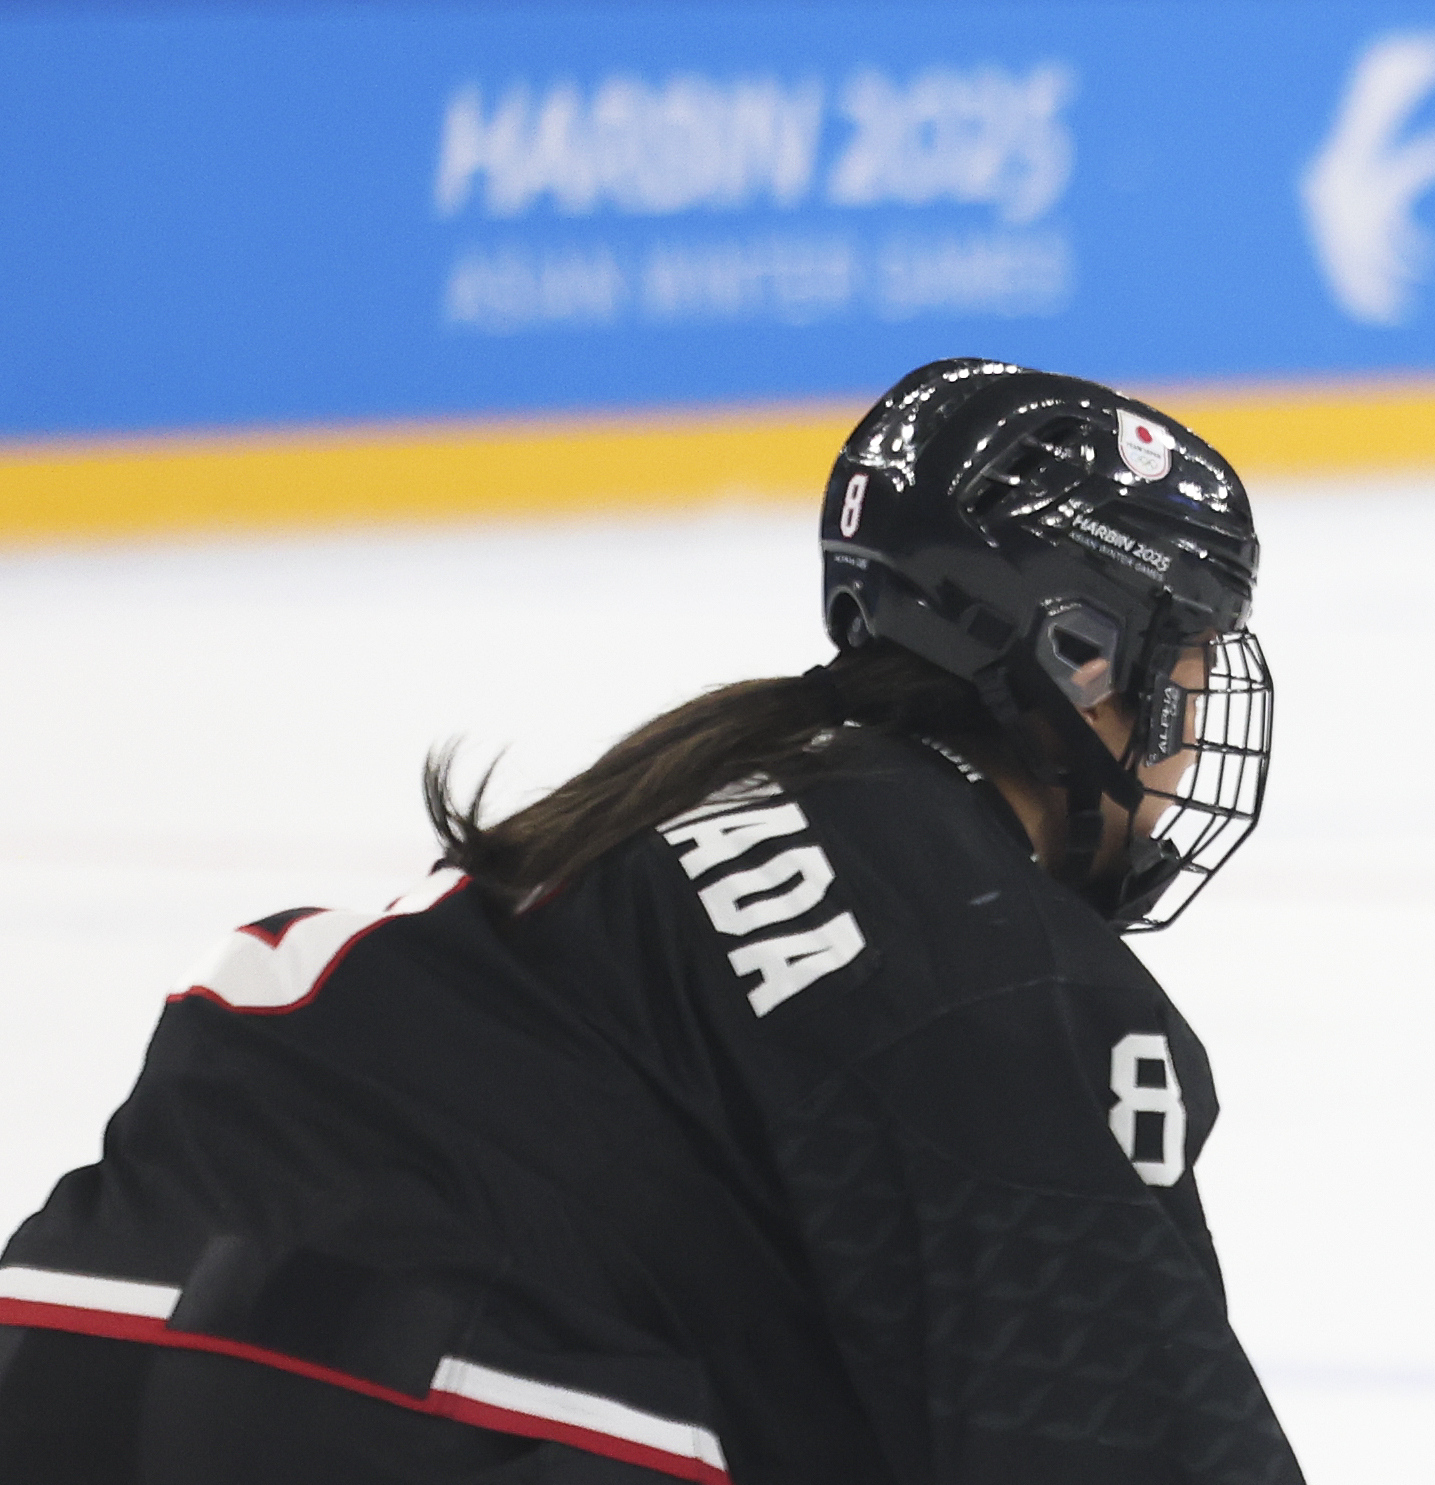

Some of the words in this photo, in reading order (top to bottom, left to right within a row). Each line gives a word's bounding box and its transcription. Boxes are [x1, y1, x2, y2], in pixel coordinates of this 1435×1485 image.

[840, 472, 869, 539] 8
[1072, 513, 1136, 552] HARBIN
[1132, 541, 1171, 572] 2025
[1109, 1033, 1187, 1188] 8
